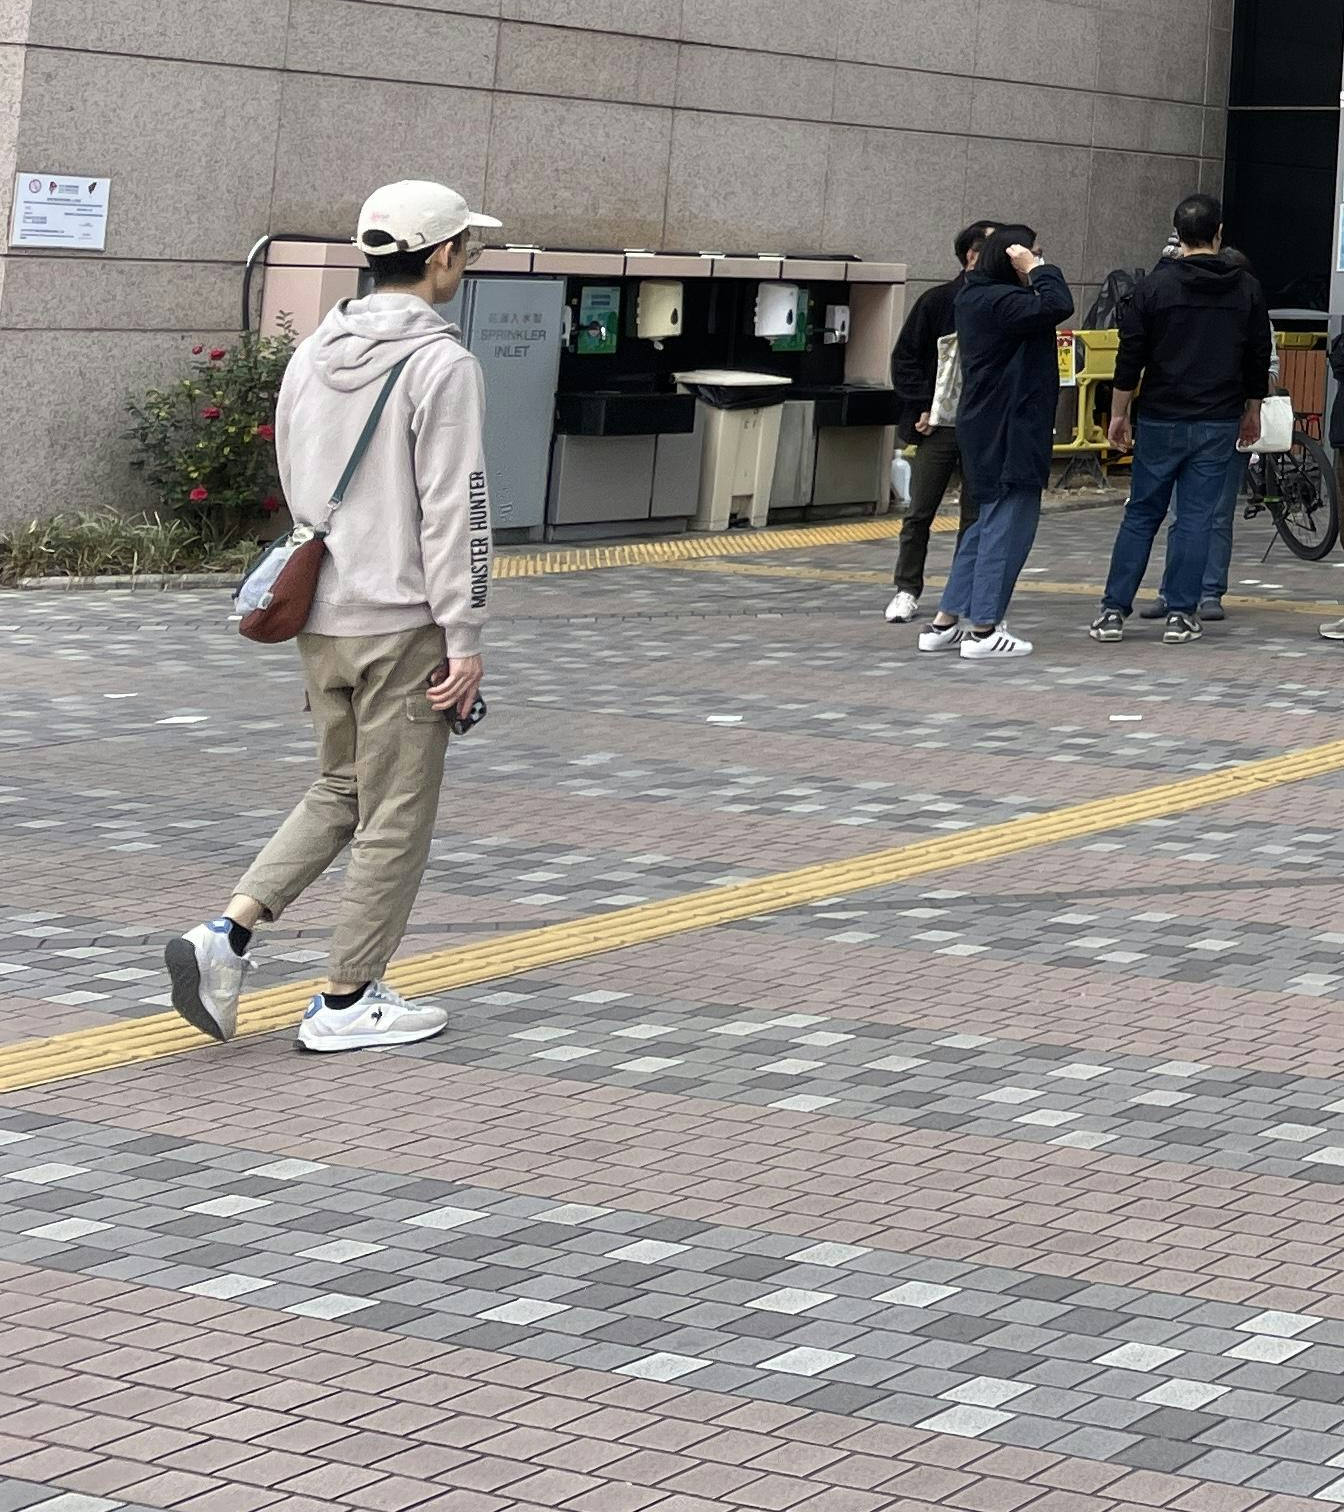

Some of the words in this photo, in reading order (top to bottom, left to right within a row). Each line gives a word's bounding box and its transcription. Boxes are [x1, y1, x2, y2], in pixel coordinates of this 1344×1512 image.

[480, 329, 547, 341] SPRINKLER
[494, 345, 531, 358] INLET
[468, 471, 488, 532] HUNTER
[470, 536, 489, 610] MONSTER
